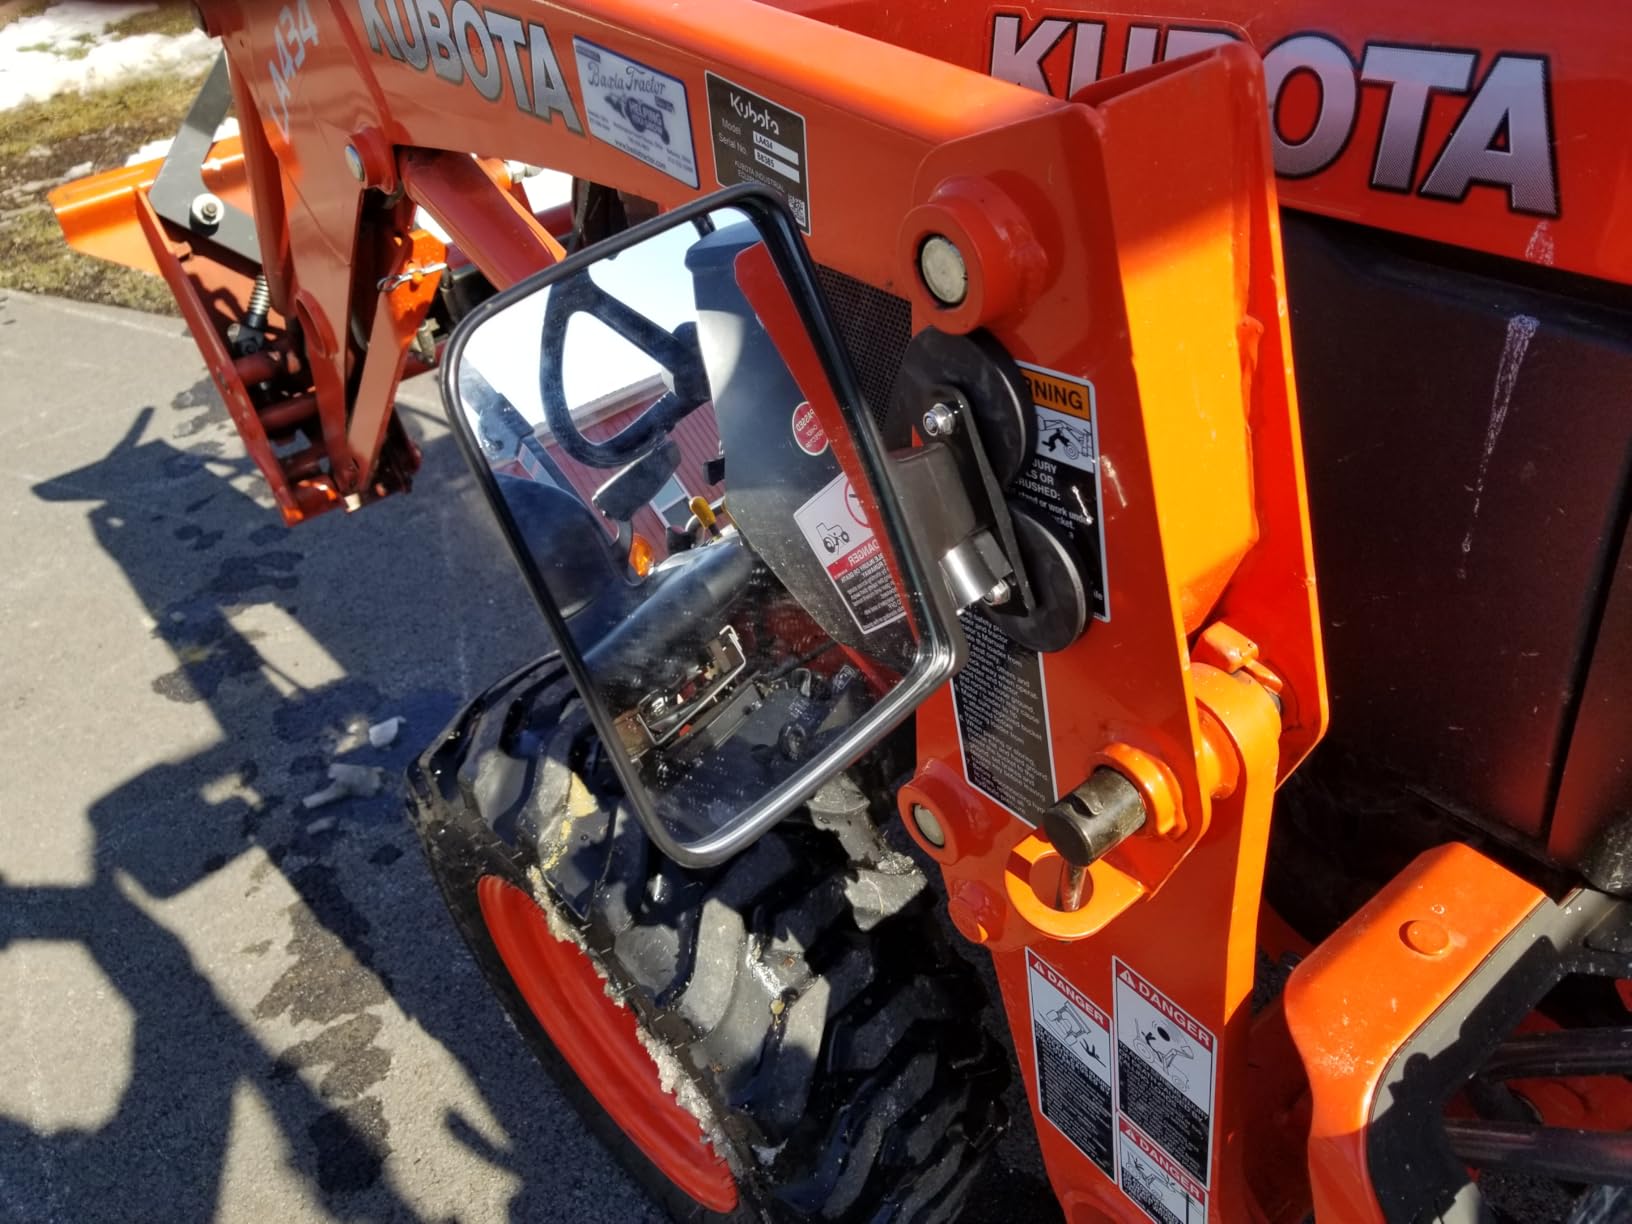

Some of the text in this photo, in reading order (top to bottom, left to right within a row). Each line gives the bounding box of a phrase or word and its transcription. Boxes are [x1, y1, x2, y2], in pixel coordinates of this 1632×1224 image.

[358, 0, 585, 137] KUBOTA
[625, 66, 666, 96] Tractor
[721, 117, 742, 136] Model
[730, 92, 780, 135] Kubota
[718, 132, 736, 151] Serial
[1025, 375, 1083, 411] RNING
[1032, 458, 1057, 474] JURY
[1040, 473, 1054, 485] OR
[1018, 478, 1061, 501] RUSHED:
[1048, 504, 1067, 516] work
[1047, 969, 1105, 1026] DANGER
[1138, 982, 1210, 1048] DANGER
[1139, 1138, 1201, 1199] DANGER
